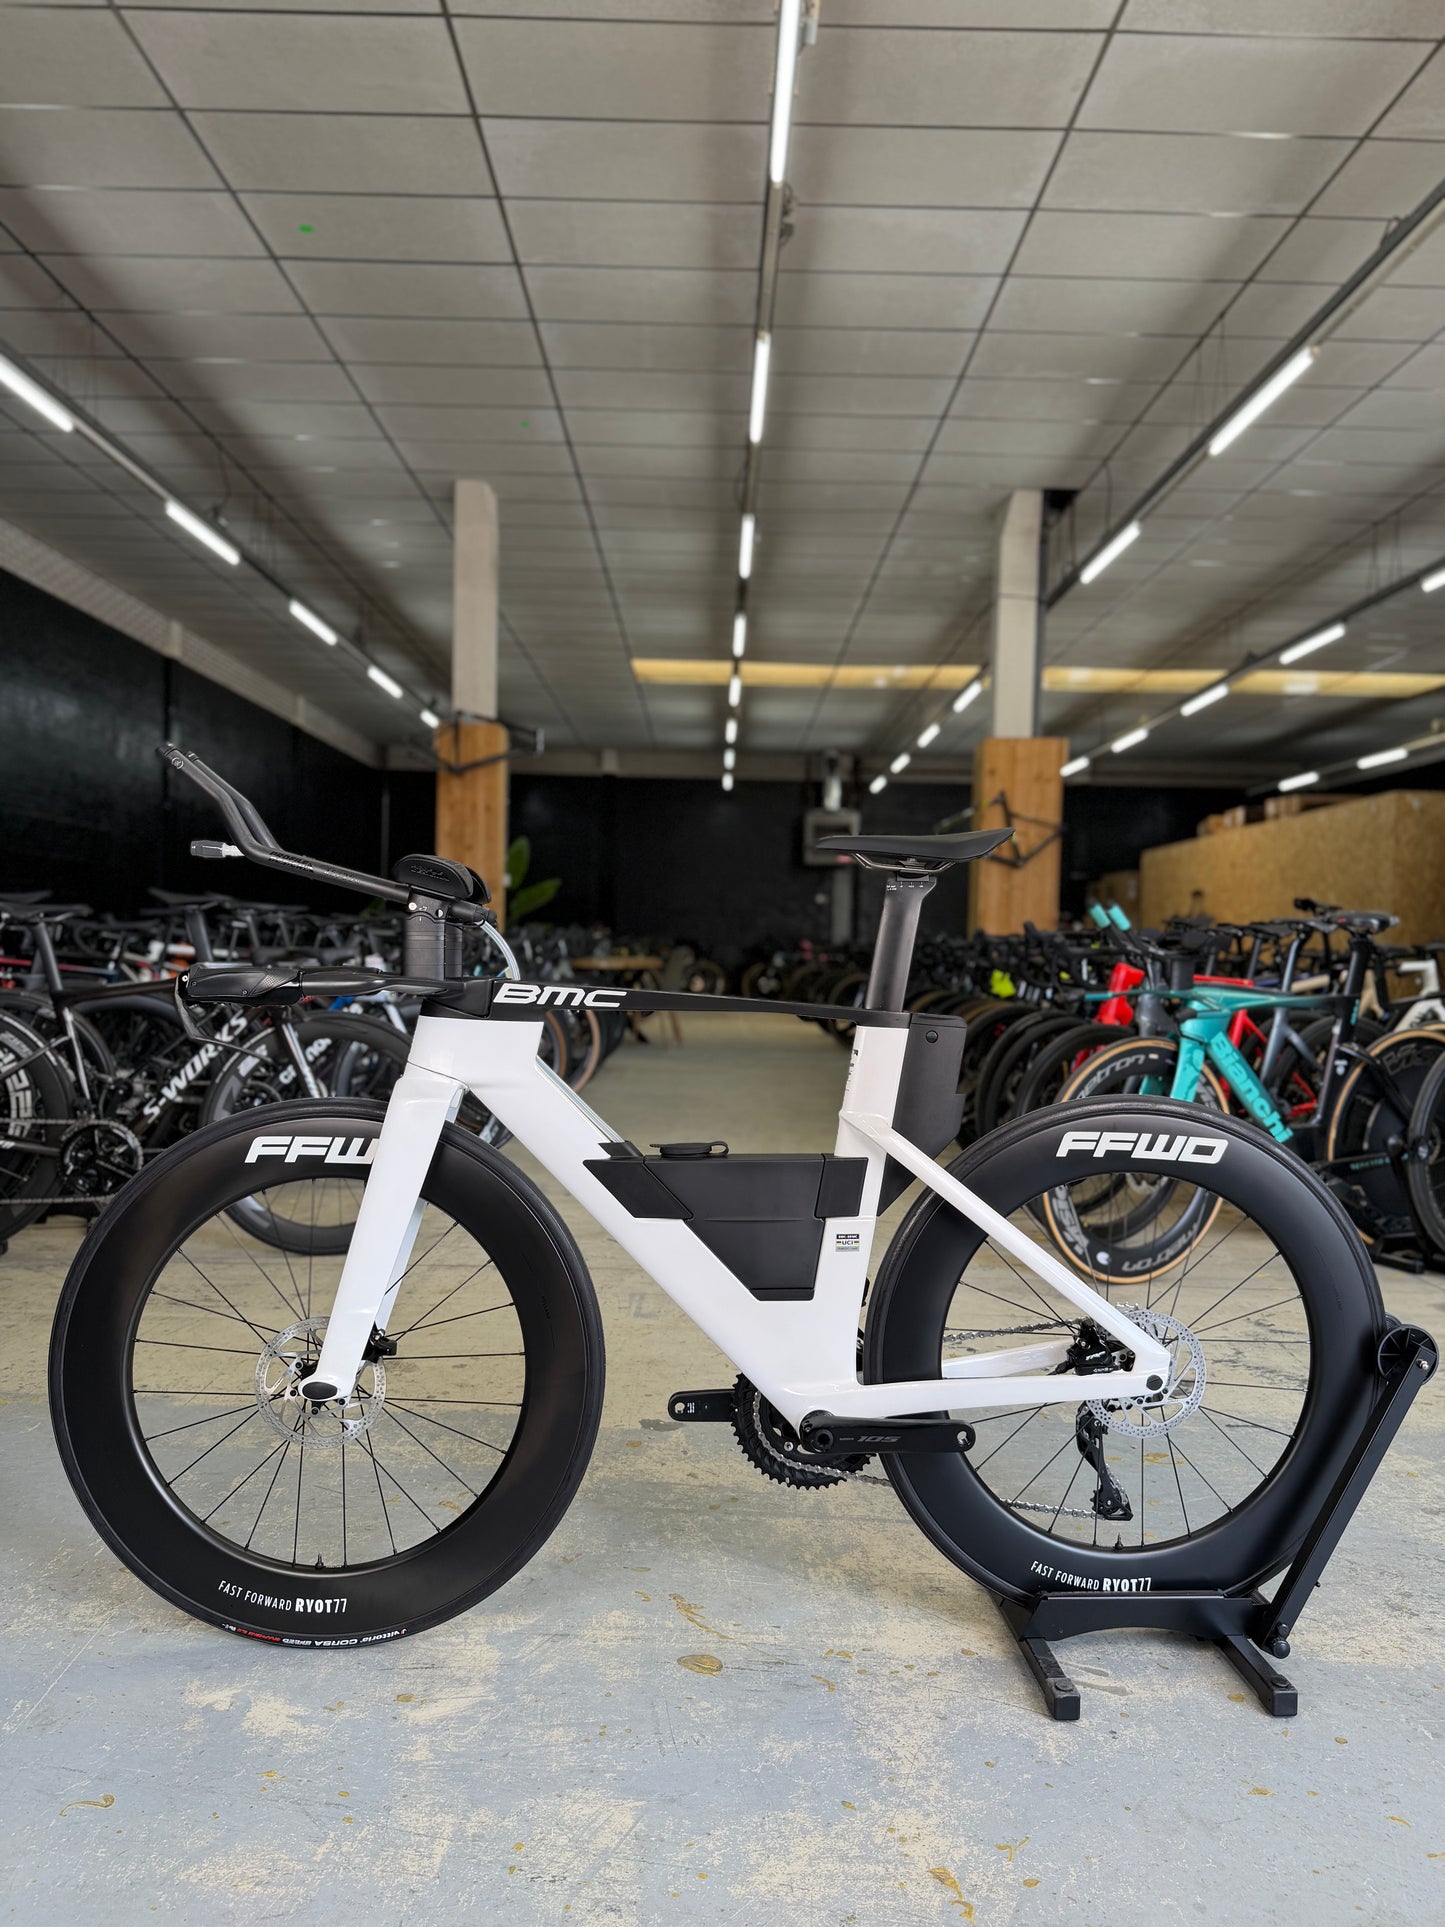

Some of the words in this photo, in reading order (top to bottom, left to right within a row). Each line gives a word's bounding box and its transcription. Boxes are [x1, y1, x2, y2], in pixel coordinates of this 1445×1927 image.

[493, 983, 627, 1008] BMC
[142, 1009, 248, 1124] S-WORKS
[1211, 1033, 1294, 1144] Bianchi
[244, 1136, 379, 1164] FFW
[1055, 1131, 1229, 1165] FFWD
[857, 1435, 901, 1444] 105
[1030, 1560, 1054, 1579] FAST
[1055, 1570, 1100, 1591] FORWARD
[1102, 1577, 1152, 1592] RYOT77
[218, 1580, 243, 1599] FAST
[244, 1590, 292, 1612] FORWARD
[295, 1597, 348, 1614] RYOT77
[314, 1638, 358, 1647] CORSA
